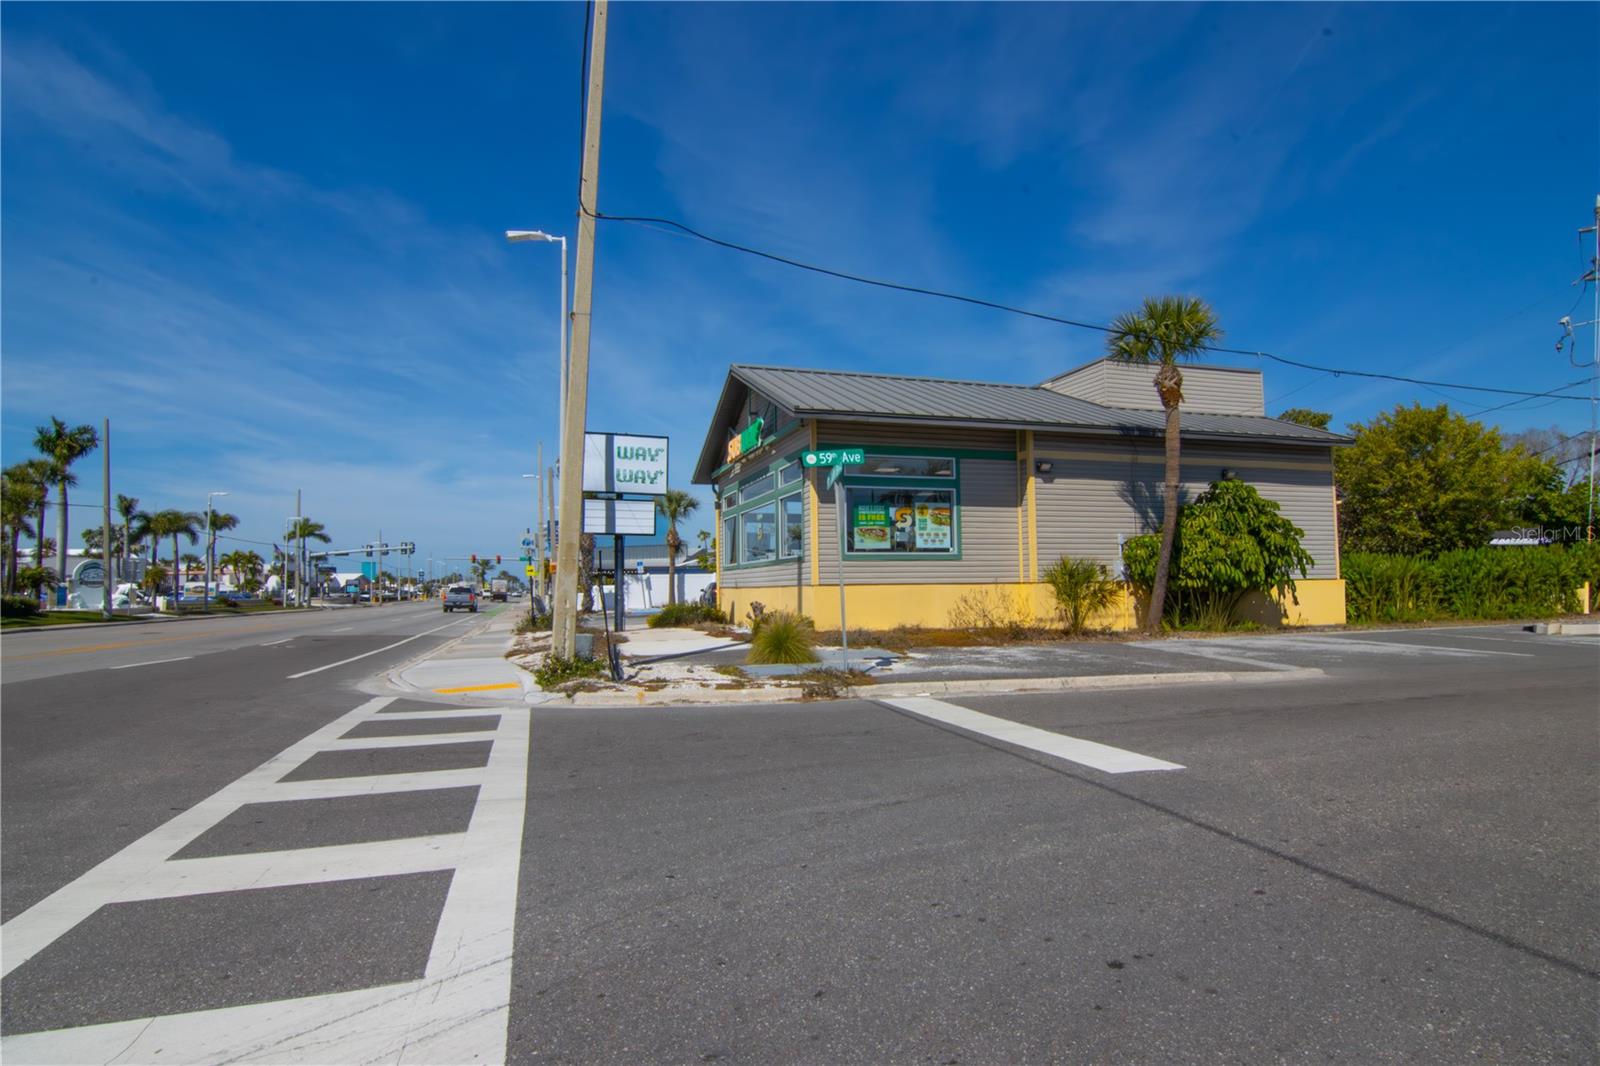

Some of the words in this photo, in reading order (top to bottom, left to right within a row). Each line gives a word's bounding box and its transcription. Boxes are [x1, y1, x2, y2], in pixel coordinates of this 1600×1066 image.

[616, 445, 664, 462] WAY
[842, 451, 861, 463] Ave
[615, 468, 664, 485] WAY
